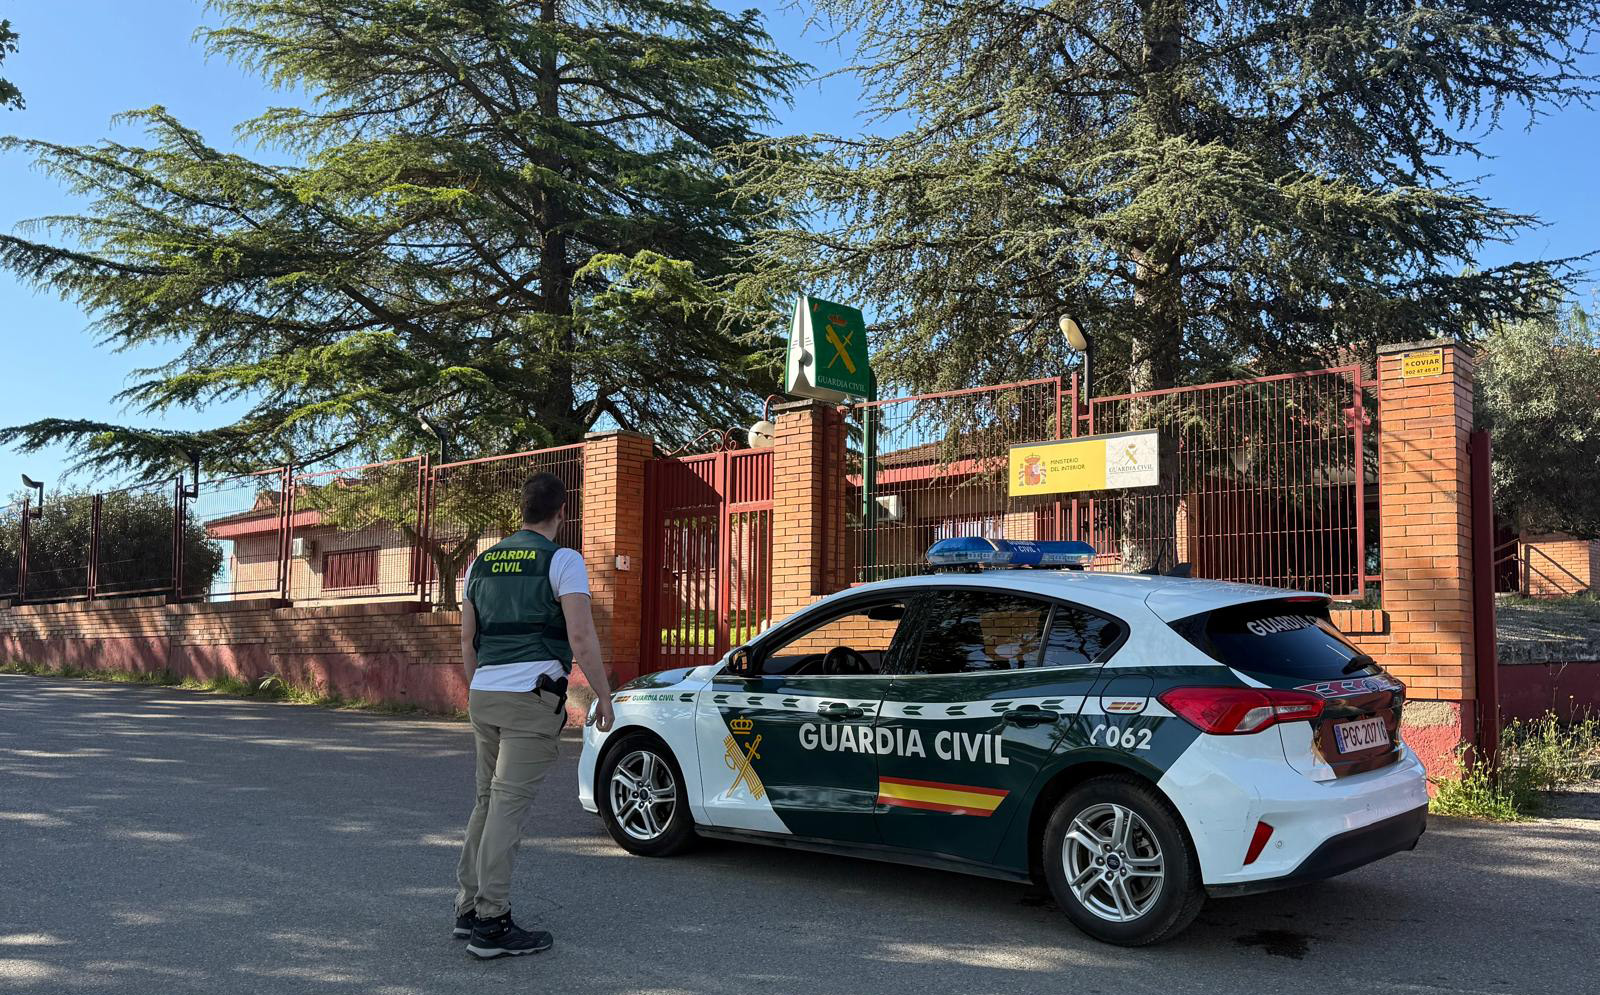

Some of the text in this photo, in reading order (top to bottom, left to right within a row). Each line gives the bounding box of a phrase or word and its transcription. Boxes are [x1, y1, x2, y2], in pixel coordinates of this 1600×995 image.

[1410, 358, 1440, 367] COVIAR
[817, 375, 866, 392] GUARDIA CIVIL
[1050, 457, 1079, 465] MINISTERIO
[1061, 463, 1085, 471] INTERIOR
[1109, 463, 1154, 473] GUARDIA CIVIL
[483, 550, 536, 562] GUARDIA
[491, 562, 523, 573] CIVIL
[1246, 615, 1309, 636] GUARDIA
[632, 693, 675, 702] GUARDIA CIVIL
[1105, 725, 1153, 750] 062
[1342, 725, 1361, 749] PGC
[799, 722, 1010, 766] GUARDIA CIVIL
